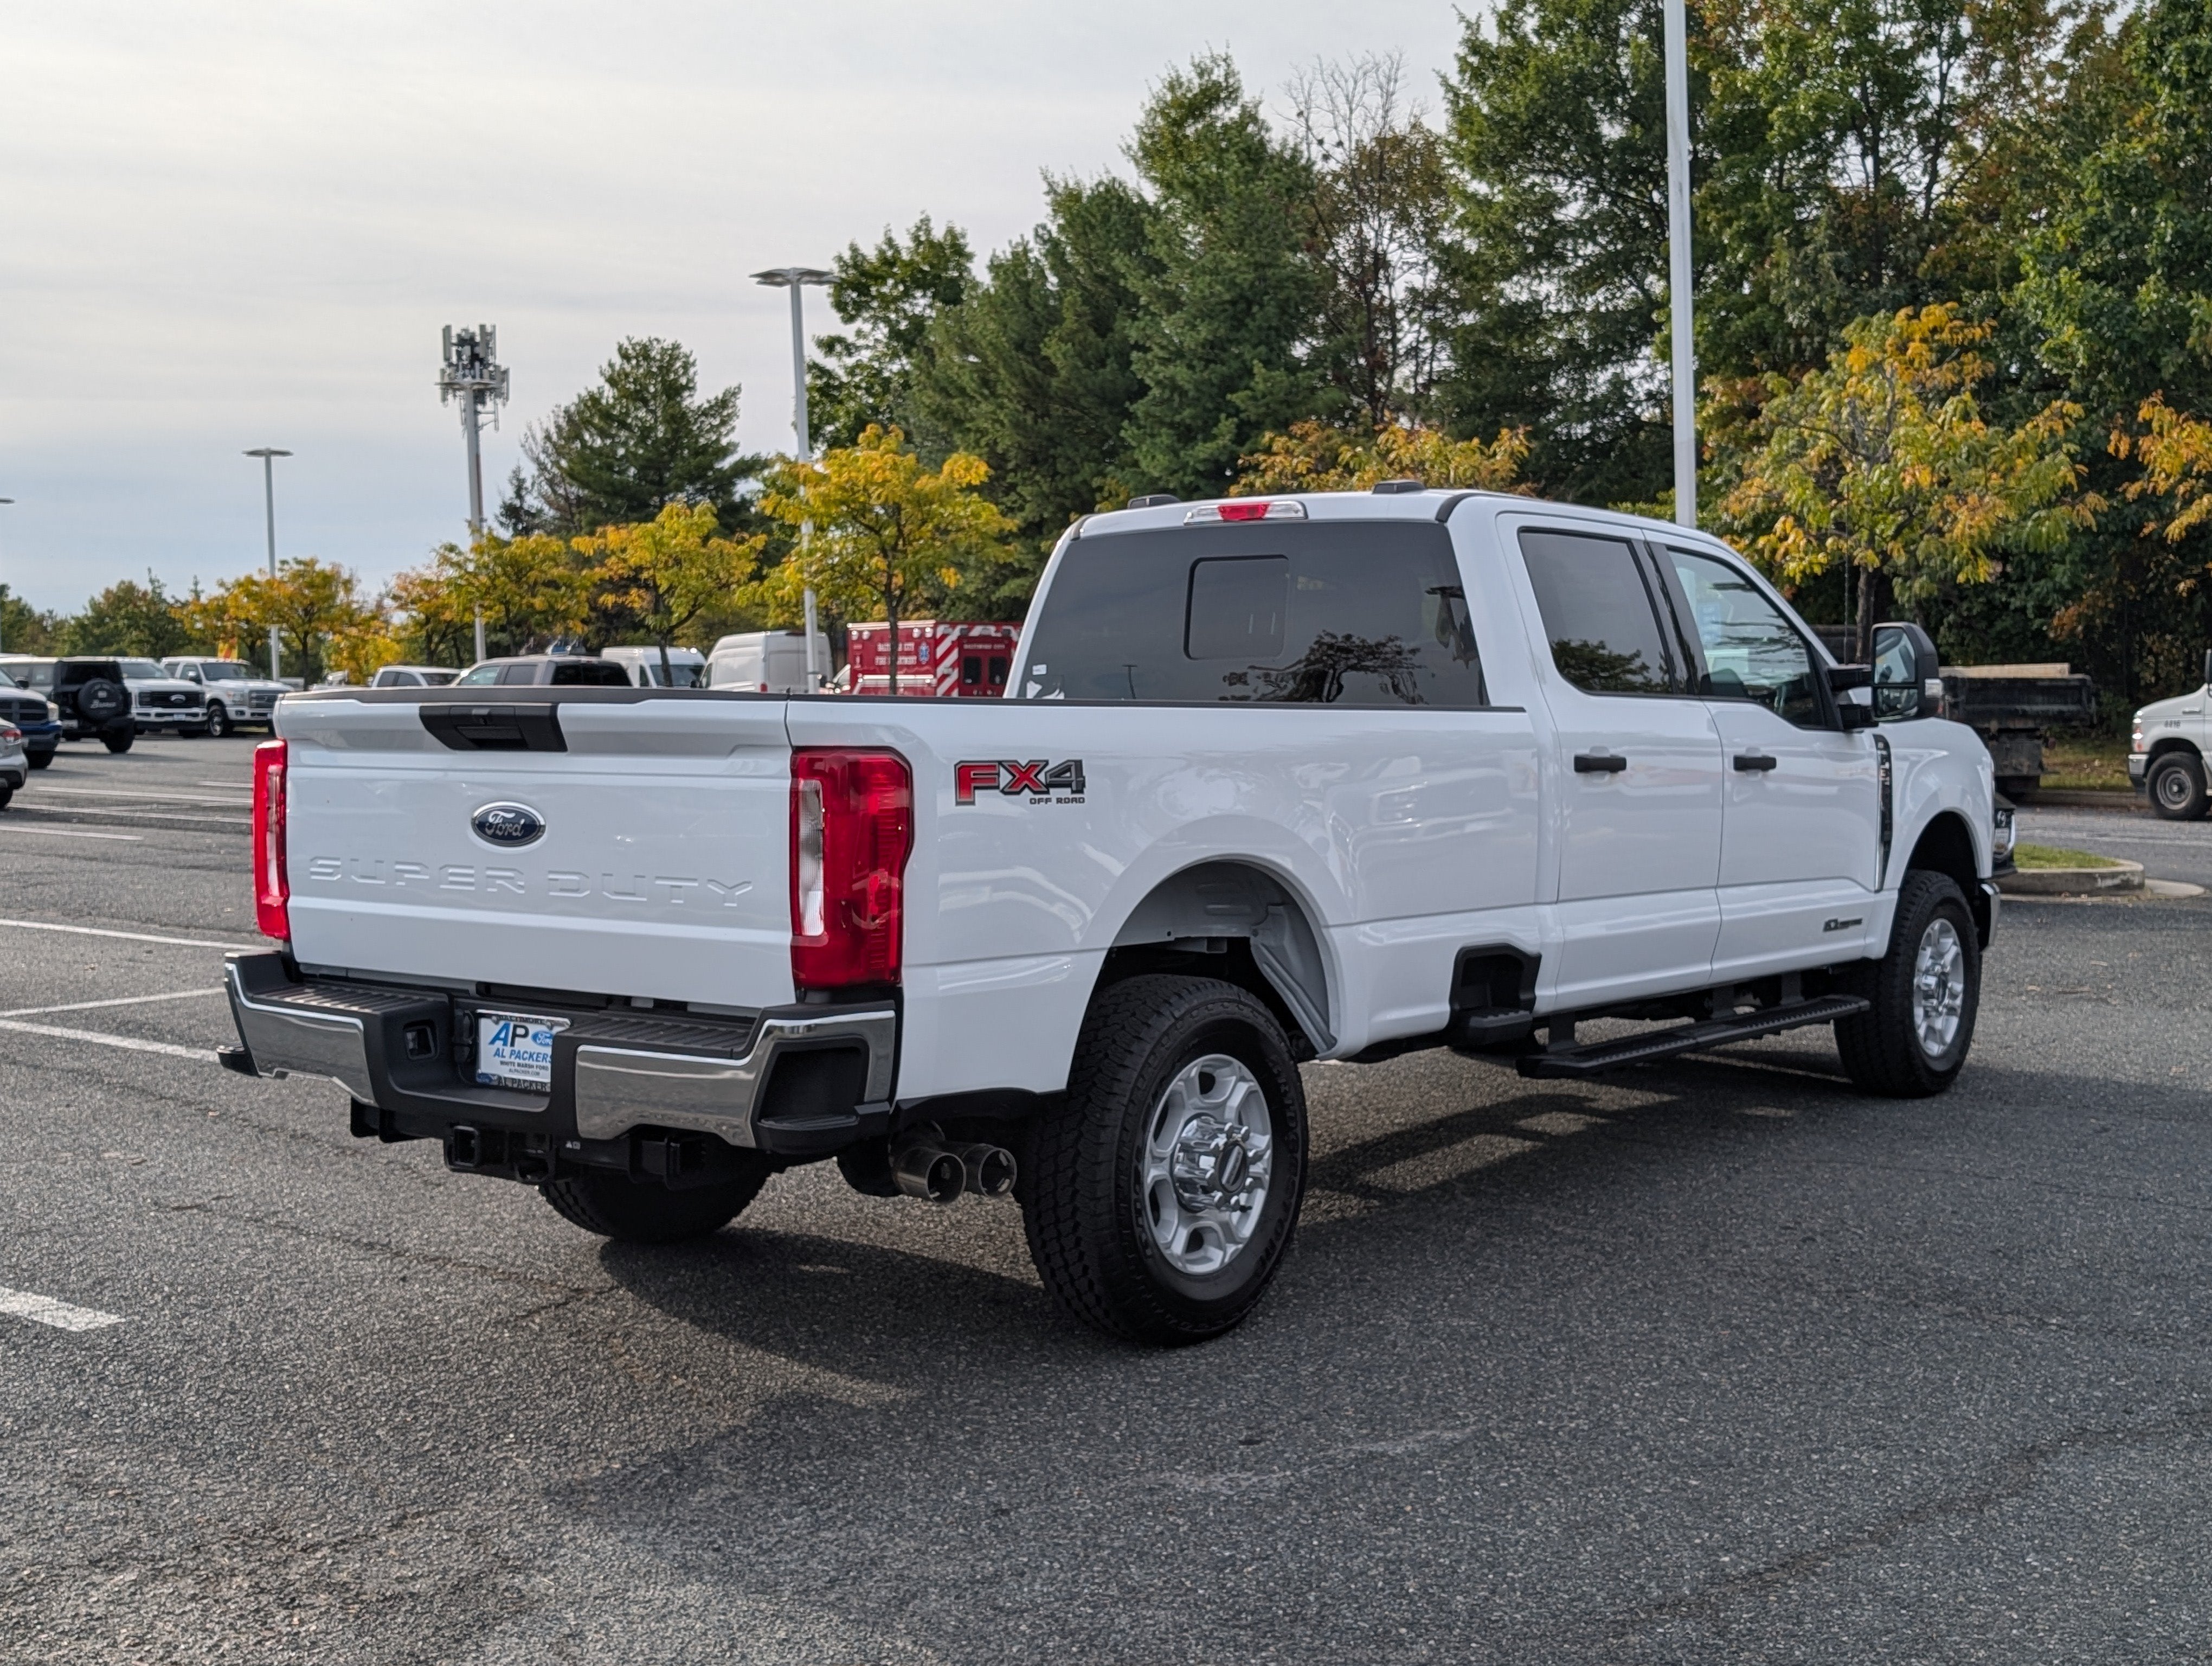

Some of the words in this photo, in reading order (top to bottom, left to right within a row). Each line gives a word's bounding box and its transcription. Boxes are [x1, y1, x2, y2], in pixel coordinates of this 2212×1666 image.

[954, 759, 1086, 806] FX4
[485, 810, 525, 837] Ford
[309, 855, 526, 894] SUPER
[547, 870, 754, 907] DUTY
[488, 1022, 529, 1047] AP
[494, 1048, 506, 1059] AL
[511, 1078, 546, 1092] PACKER
